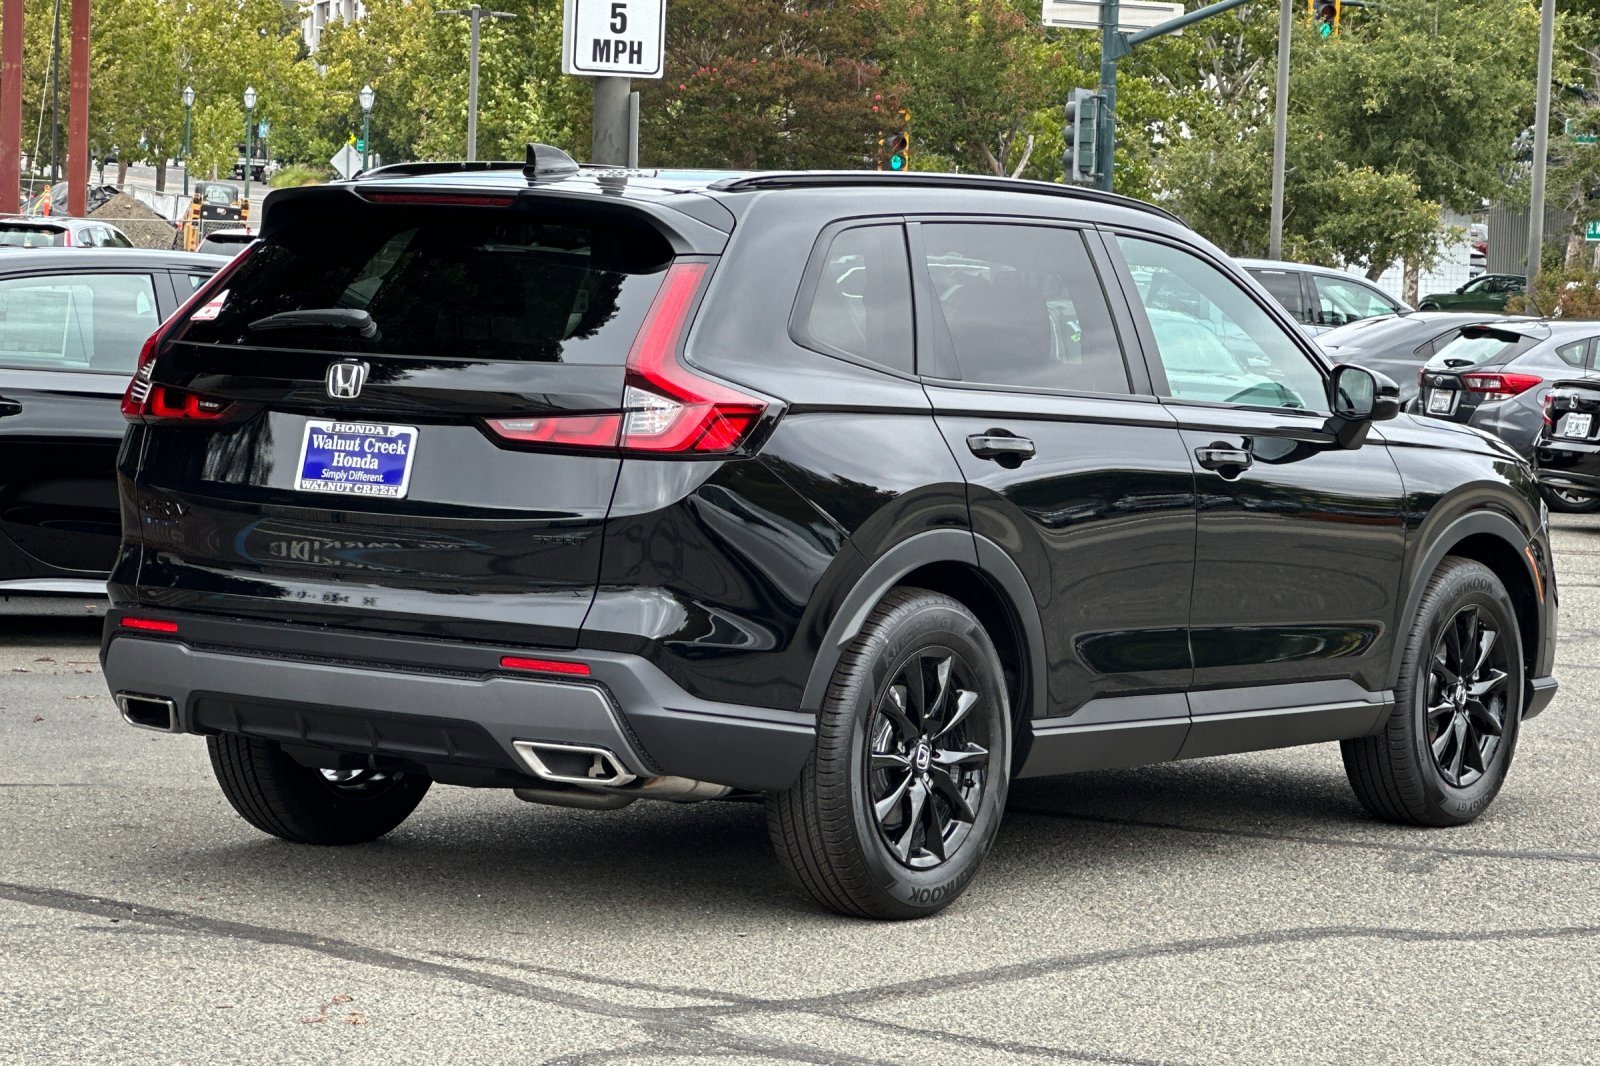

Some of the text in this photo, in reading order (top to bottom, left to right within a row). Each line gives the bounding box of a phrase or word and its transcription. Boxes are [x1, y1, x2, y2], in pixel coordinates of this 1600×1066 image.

[609, 3, 627, 34] 5
[592, 38, 643, 65] MPH
[334, 423, 384, 435] HONDA
[313, 434, 406, 455] Walnut Creek
[332, 452, 378, 469] Honda
[321, 468, 384, 482] Simply Different.
[301, 479, 398, 496] WALNUT CREEK
